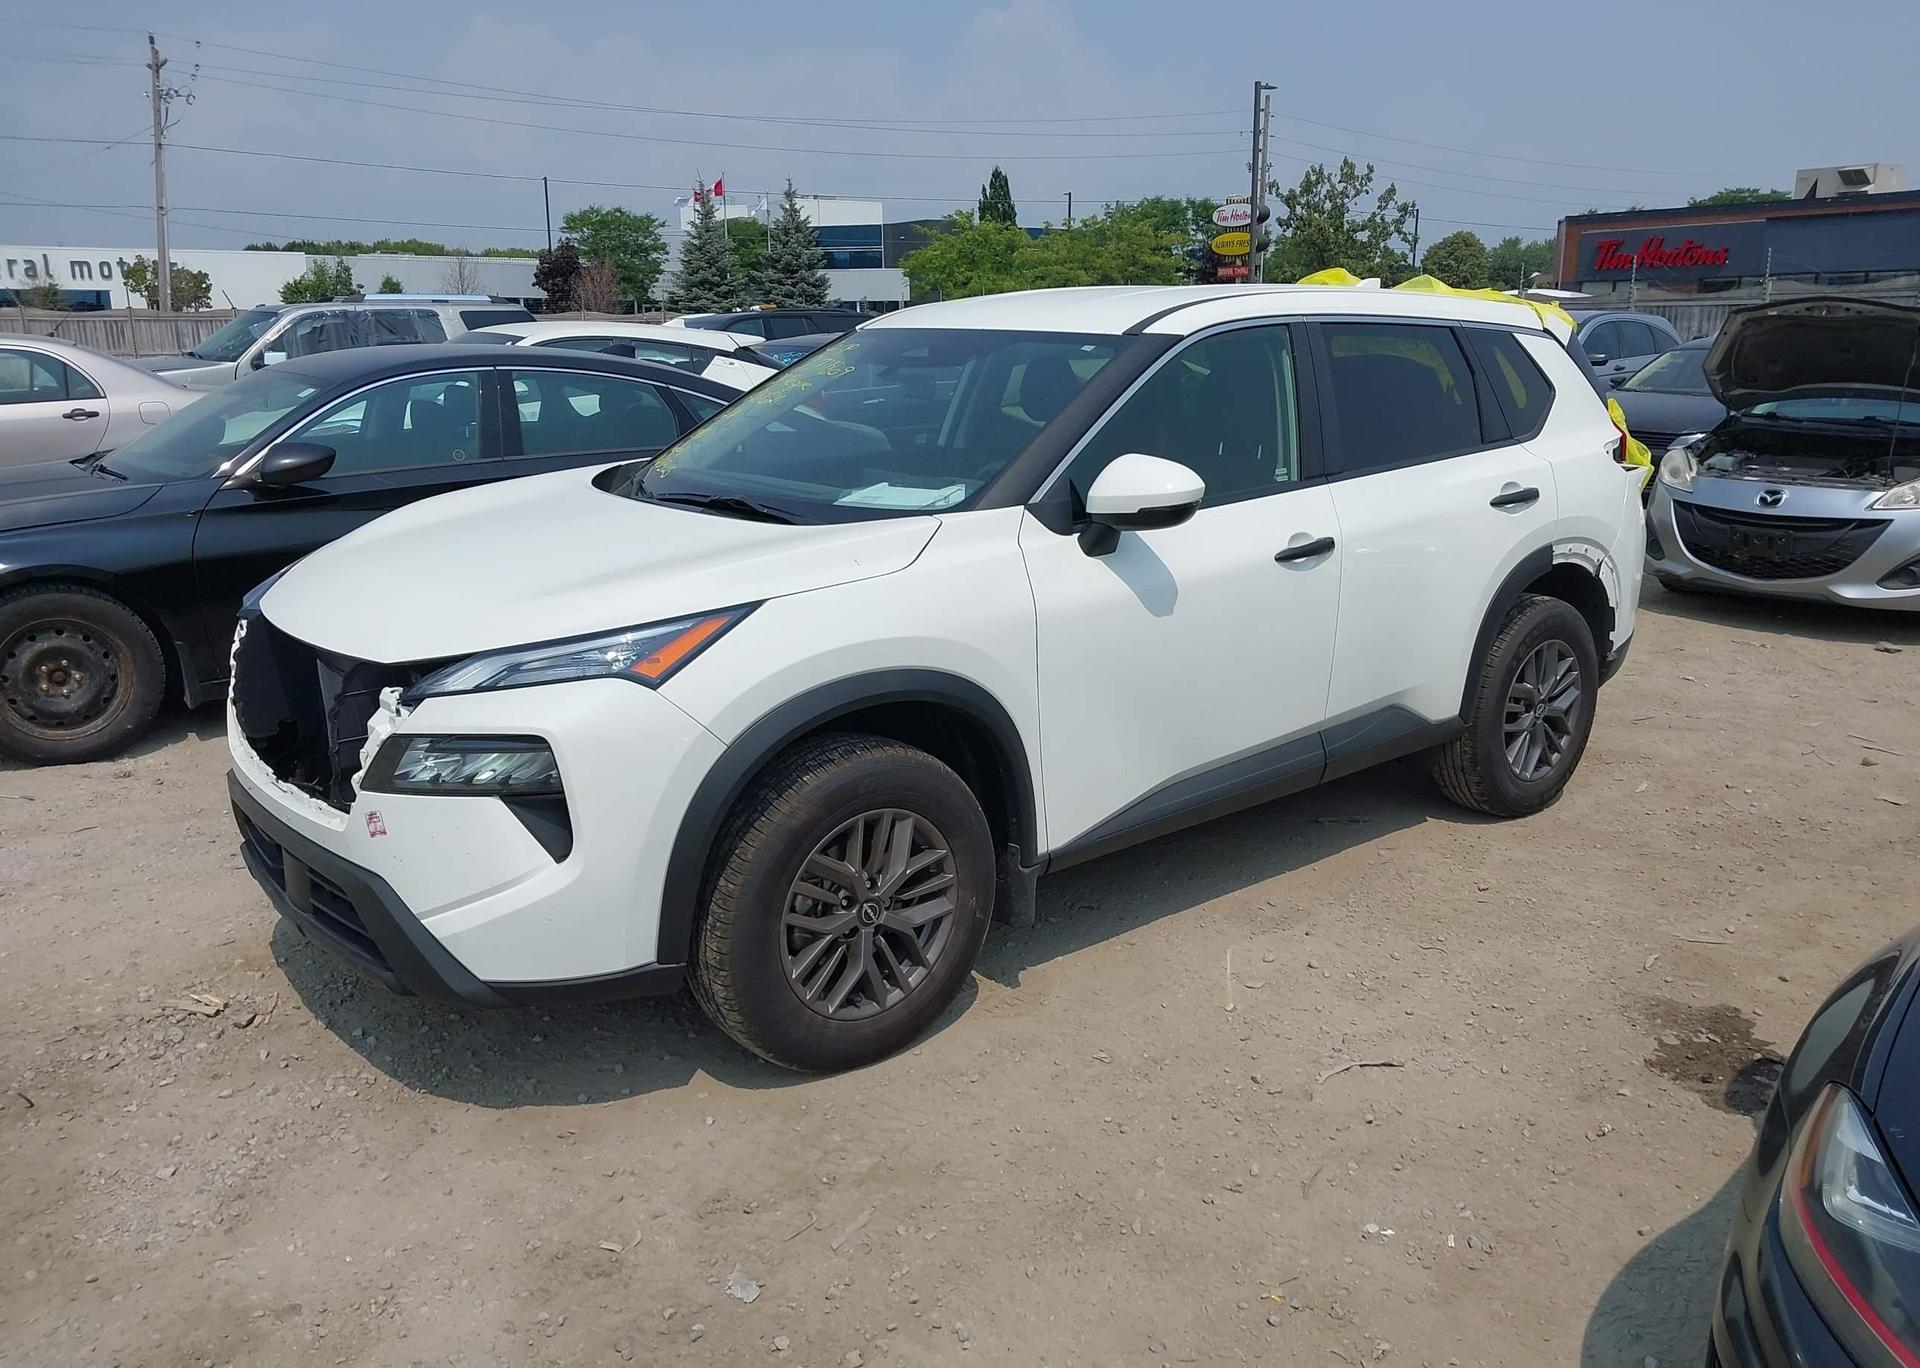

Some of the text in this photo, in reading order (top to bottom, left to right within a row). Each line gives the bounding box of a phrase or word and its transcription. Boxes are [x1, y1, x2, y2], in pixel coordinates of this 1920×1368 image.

[1217, 210, 1229, 222] Tim
[1235, 239, 1250, 248] FRES
[1595, 235, 1728, 271] Tim Hortons
